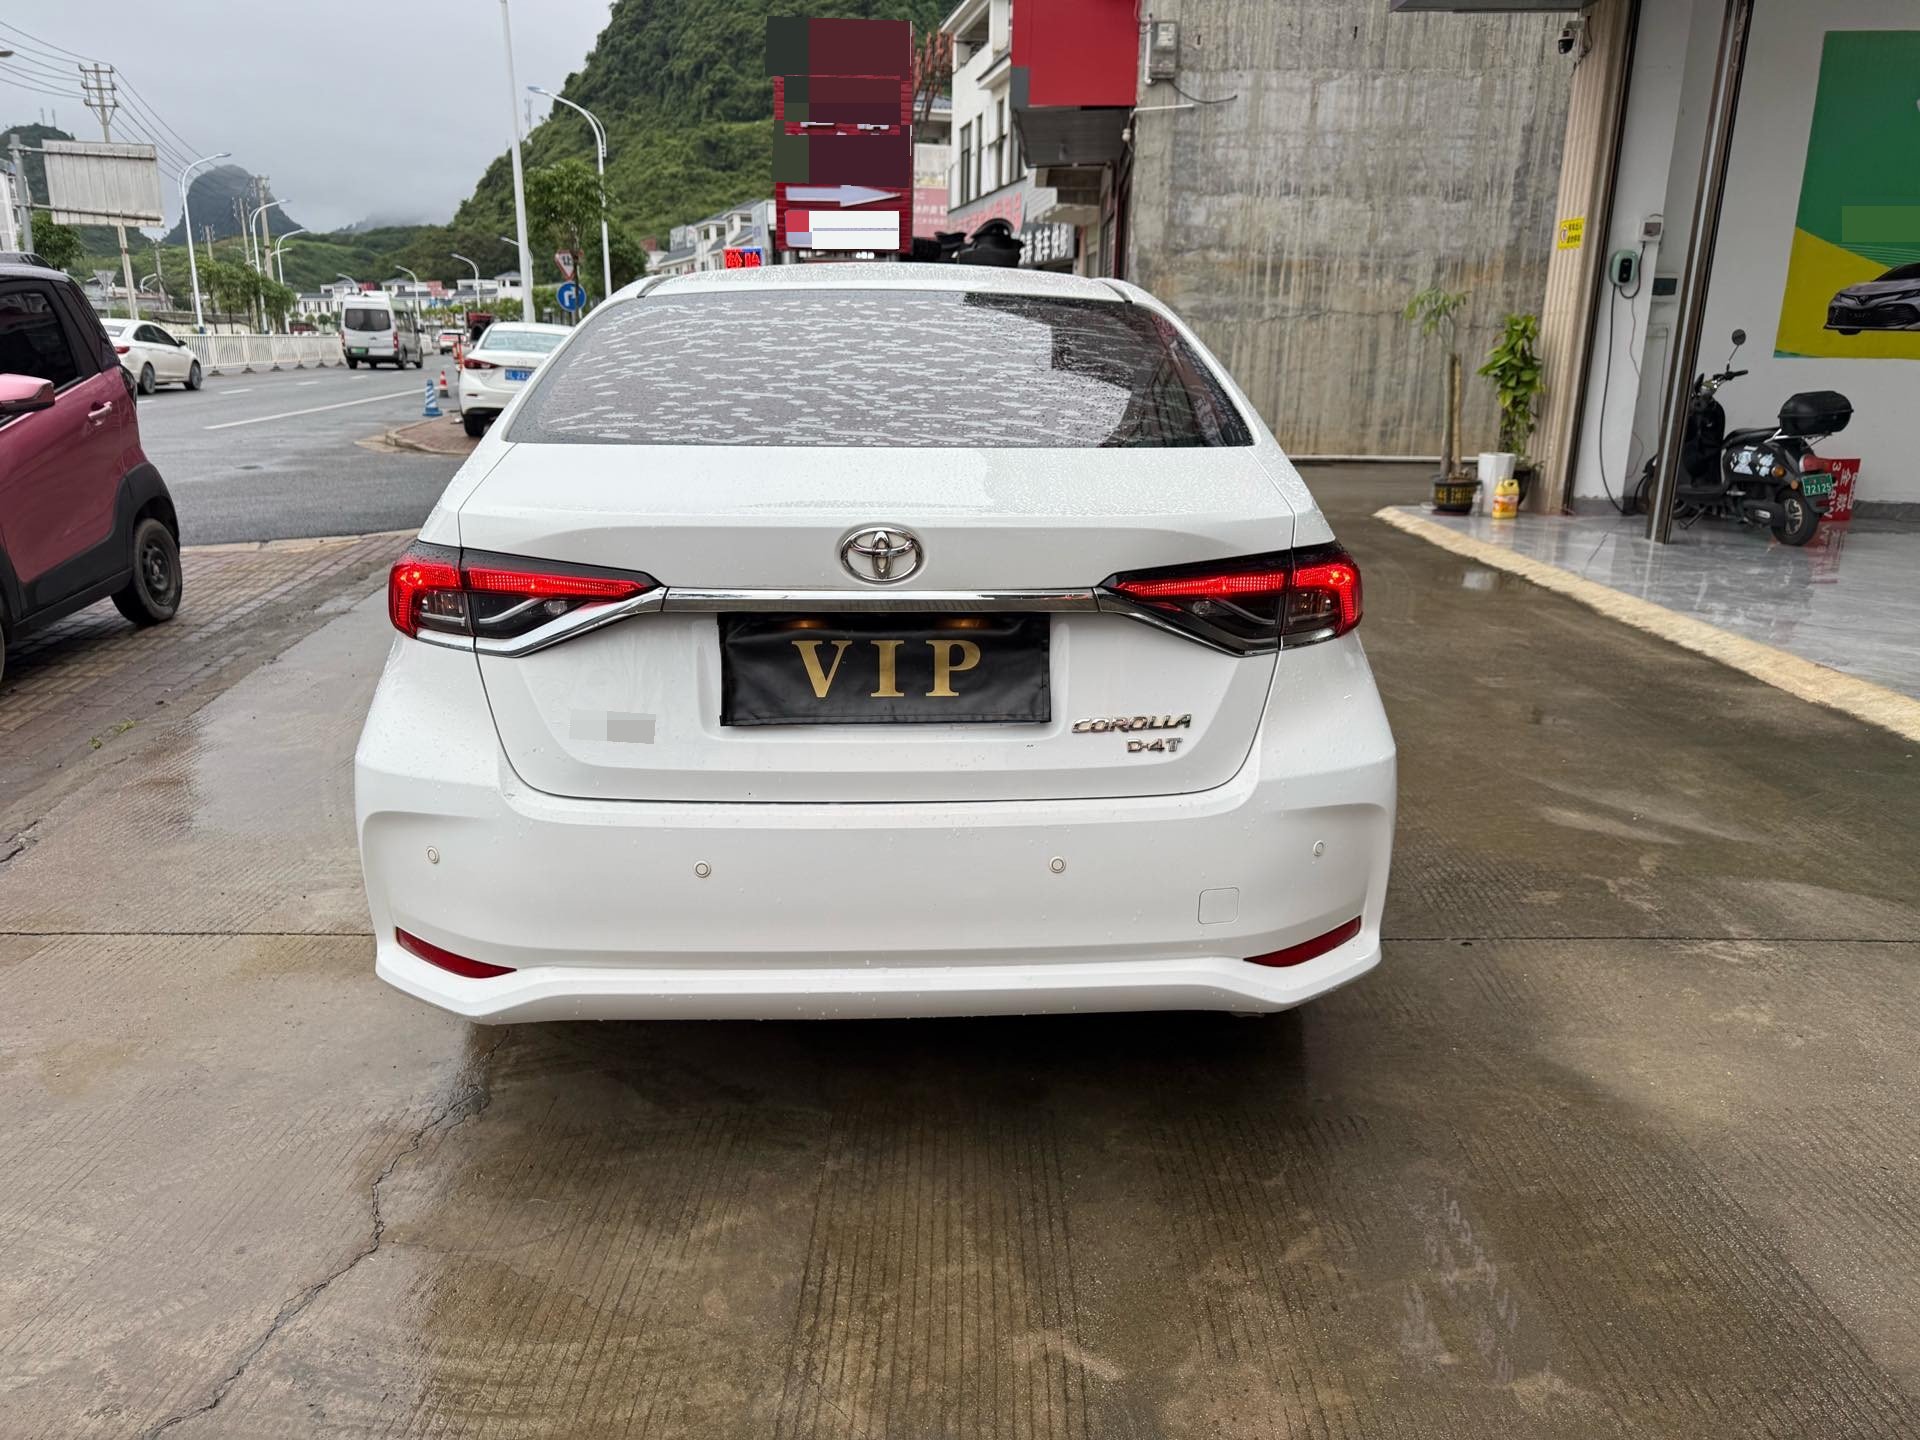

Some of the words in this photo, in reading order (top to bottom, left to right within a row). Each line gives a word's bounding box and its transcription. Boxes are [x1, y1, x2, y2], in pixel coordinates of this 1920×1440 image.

[1805, 484, 1831, 495] 72125
[791, 639, 981, 698] VIP
[1072, 714, 1191, 733] COROLLA
[1127, 737, 1182, 752] D-4T
